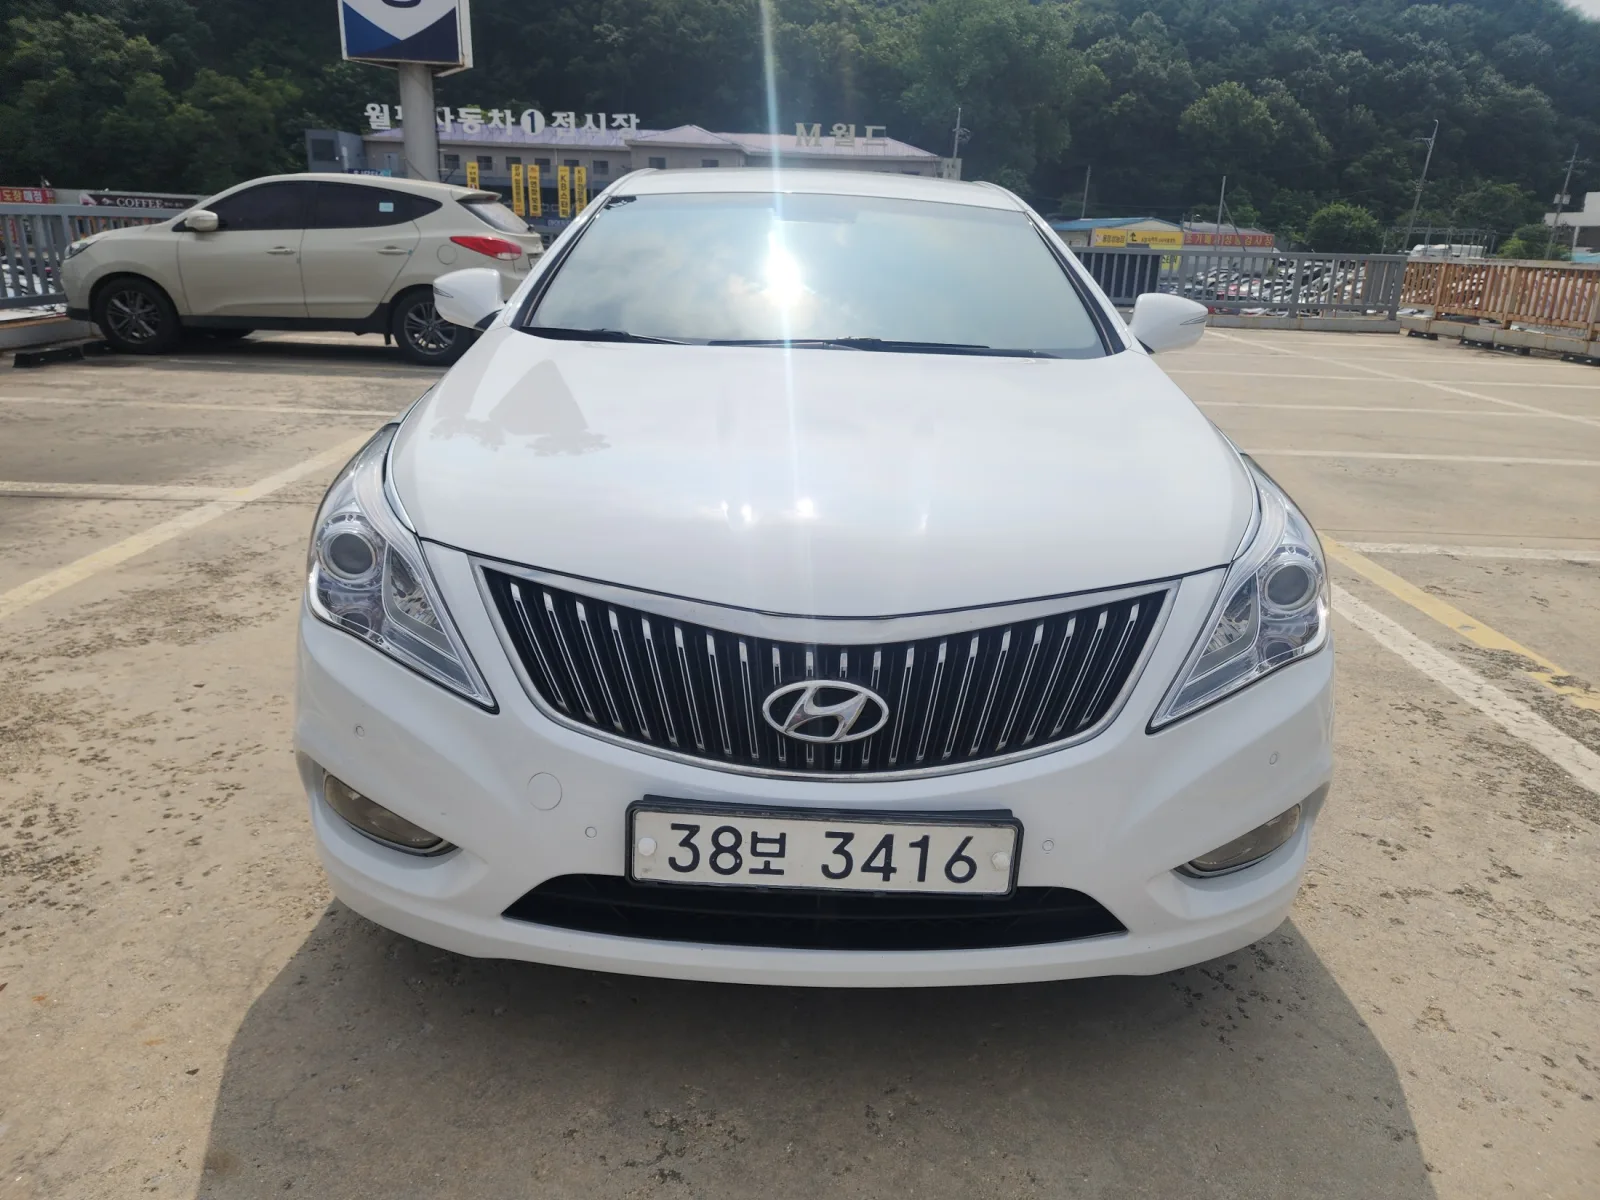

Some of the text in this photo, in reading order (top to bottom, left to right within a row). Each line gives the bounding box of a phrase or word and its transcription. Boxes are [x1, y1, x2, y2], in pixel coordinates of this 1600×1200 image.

[116, 197, 164, 208] COFFEE
[668, 823, 978, 884] 38보 3416
